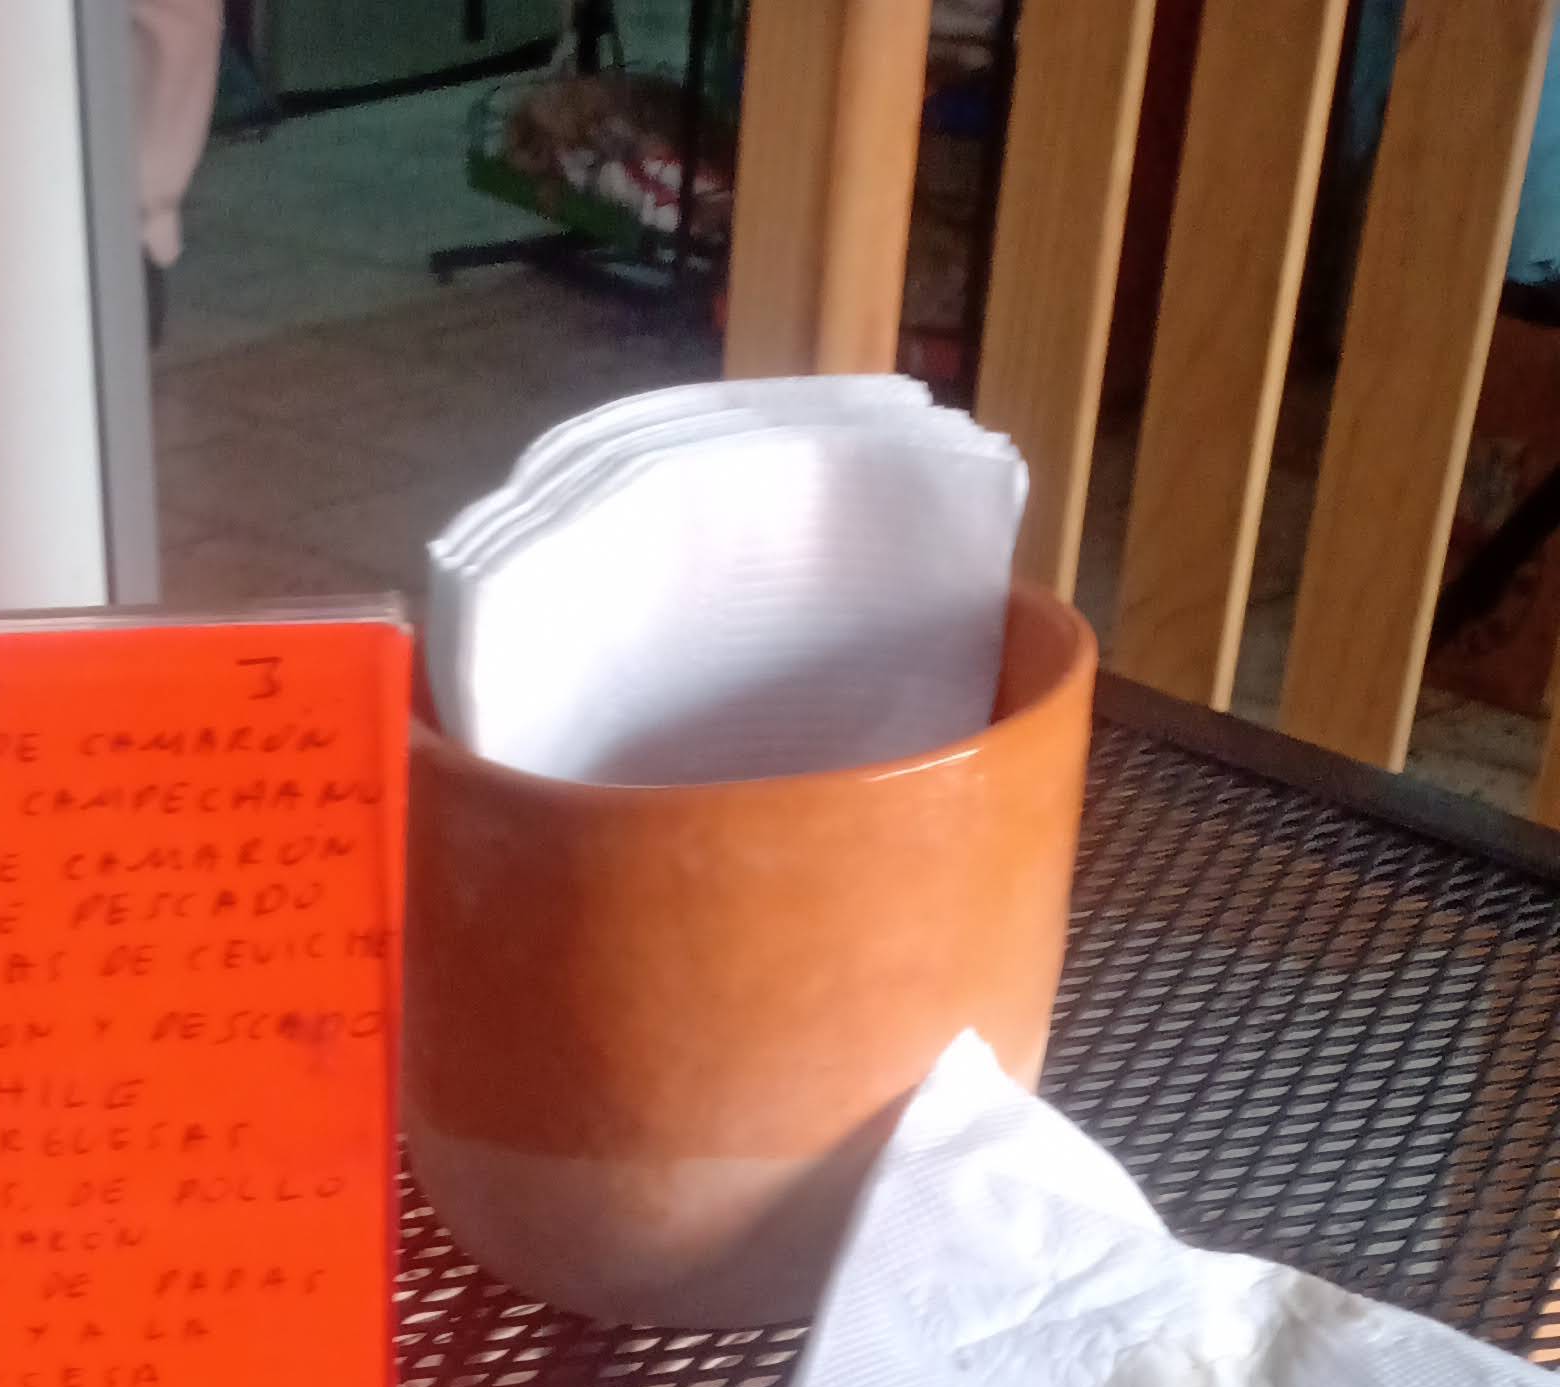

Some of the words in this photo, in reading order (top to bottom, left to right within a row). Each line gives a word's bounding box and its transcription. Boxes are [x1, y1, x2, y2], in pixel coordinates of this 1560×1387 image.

[99, 944, 156, 979] DE
[66, 1176, 128, 1207] DE
[41, 1272, 93, 1301] DE
